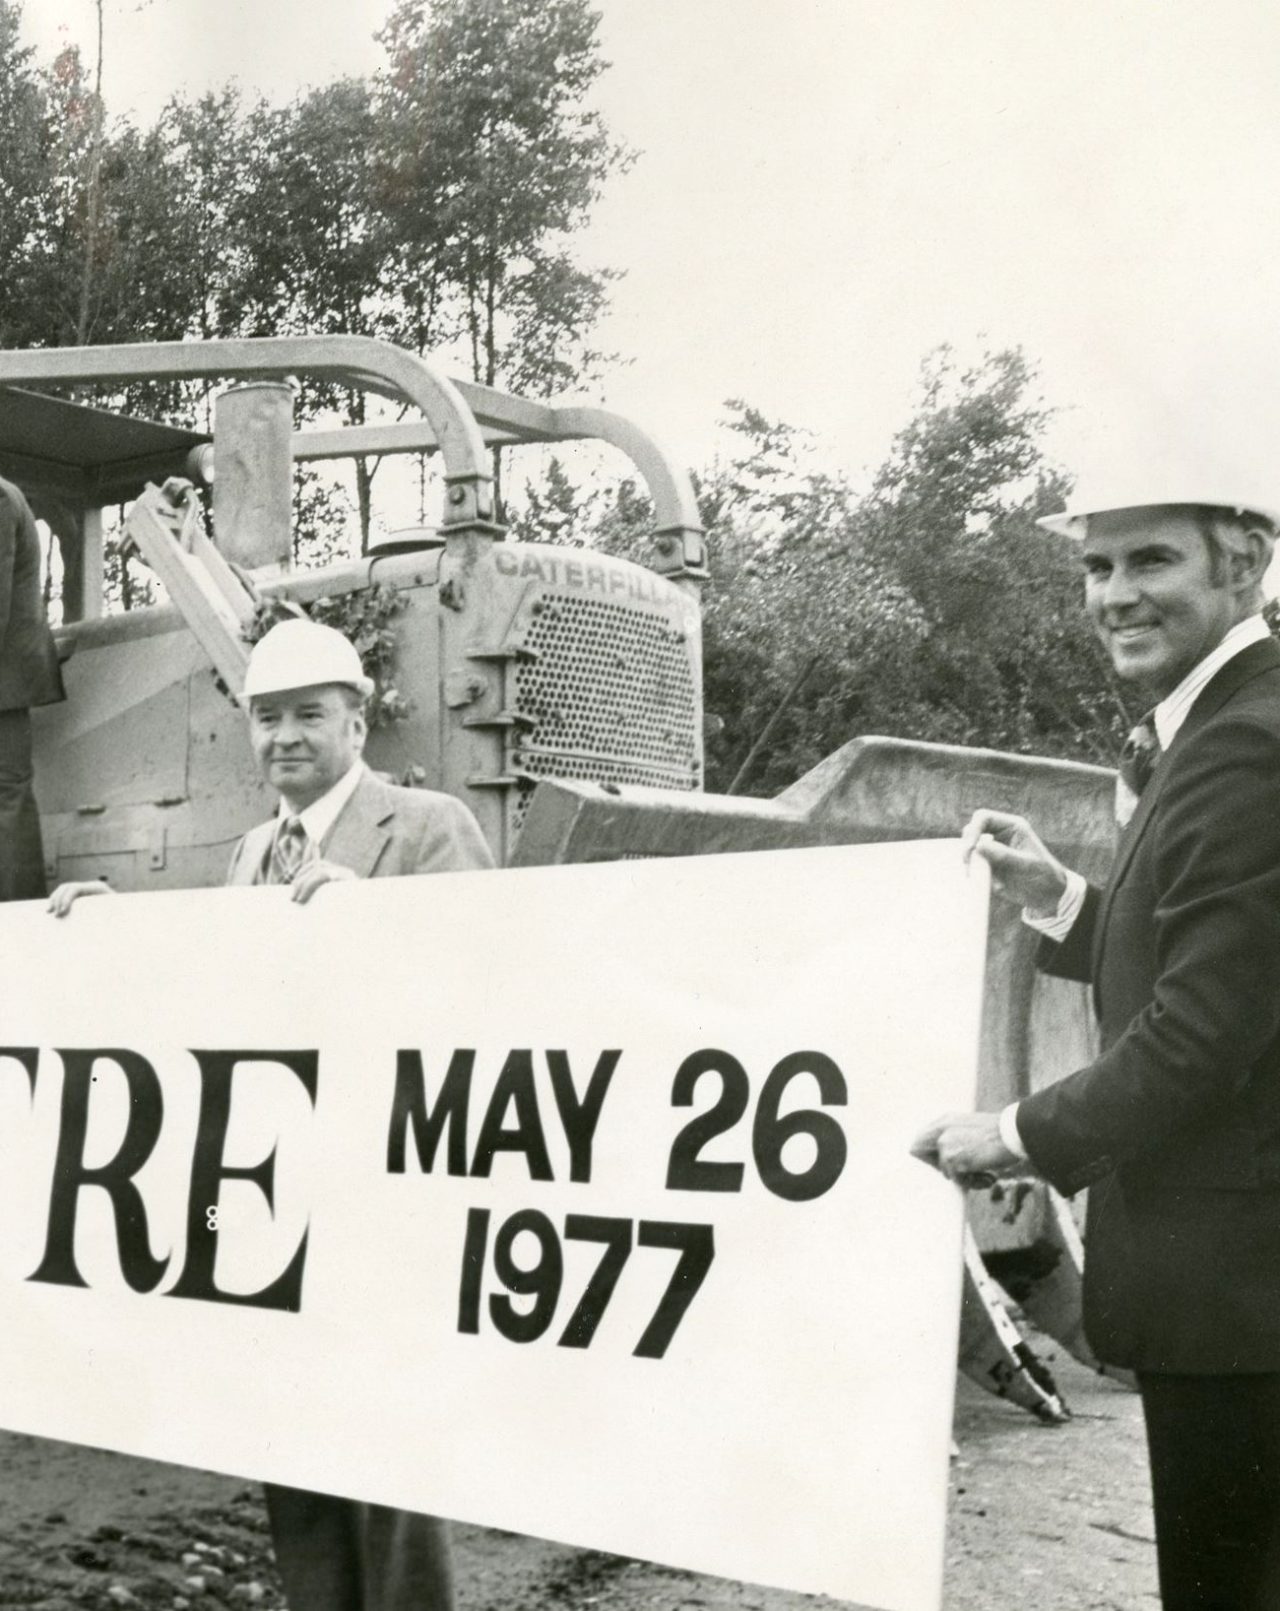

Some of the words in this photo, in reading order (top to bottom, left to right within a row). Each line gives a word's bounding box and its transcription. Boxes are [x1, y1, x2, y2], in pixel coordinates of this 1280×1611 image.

[387, 1048, 623, 1184] MAY
[665, 1048, 848, 1202] 26
[457, 1207, 715, 1359] 1977
